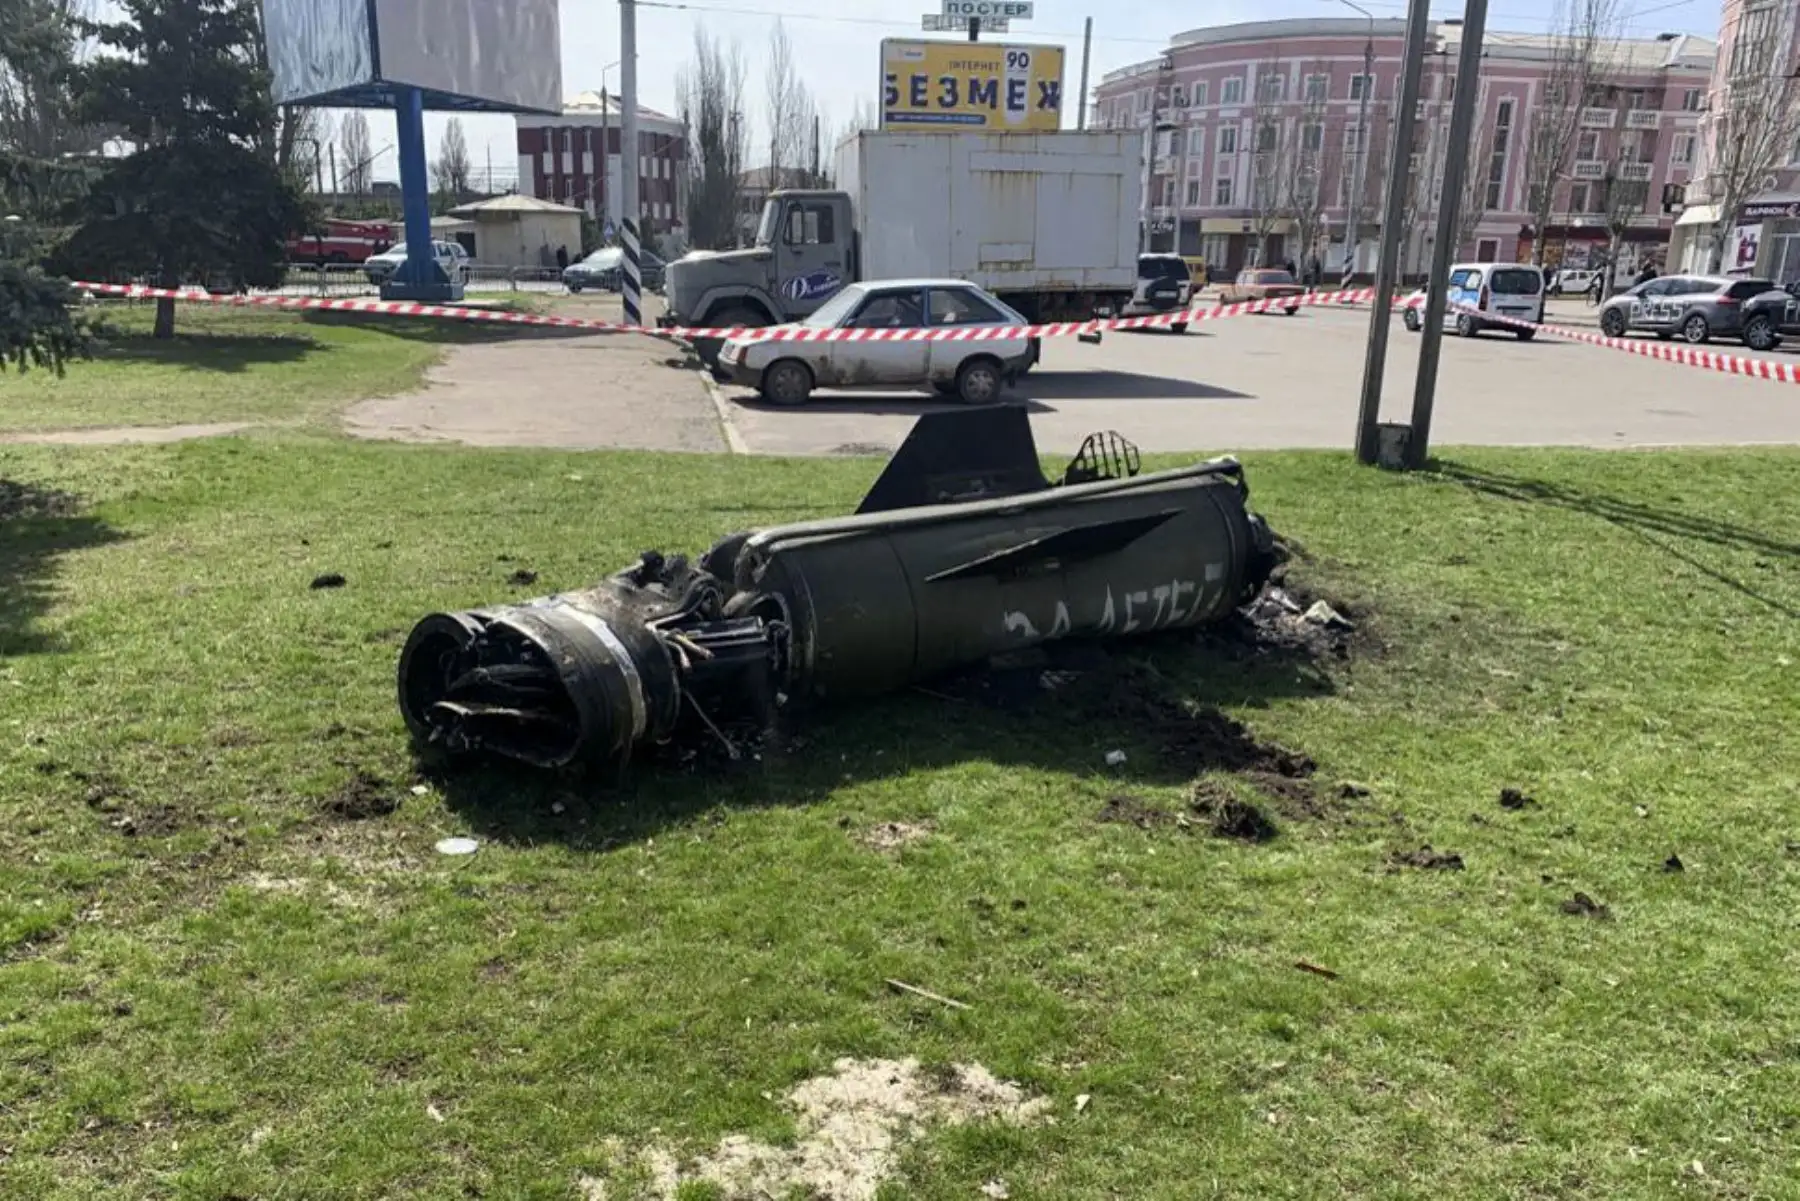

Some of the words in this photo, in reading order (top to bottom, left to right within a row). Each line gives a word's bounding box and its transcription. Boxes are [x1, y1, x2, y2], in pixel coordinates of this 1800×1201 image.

[947, 2, 1028, 15] ПОСТЕР
[949, 60, 1000, 71] ІНТЕРНЕТ
[1007, 51, 1029, 69] 90
